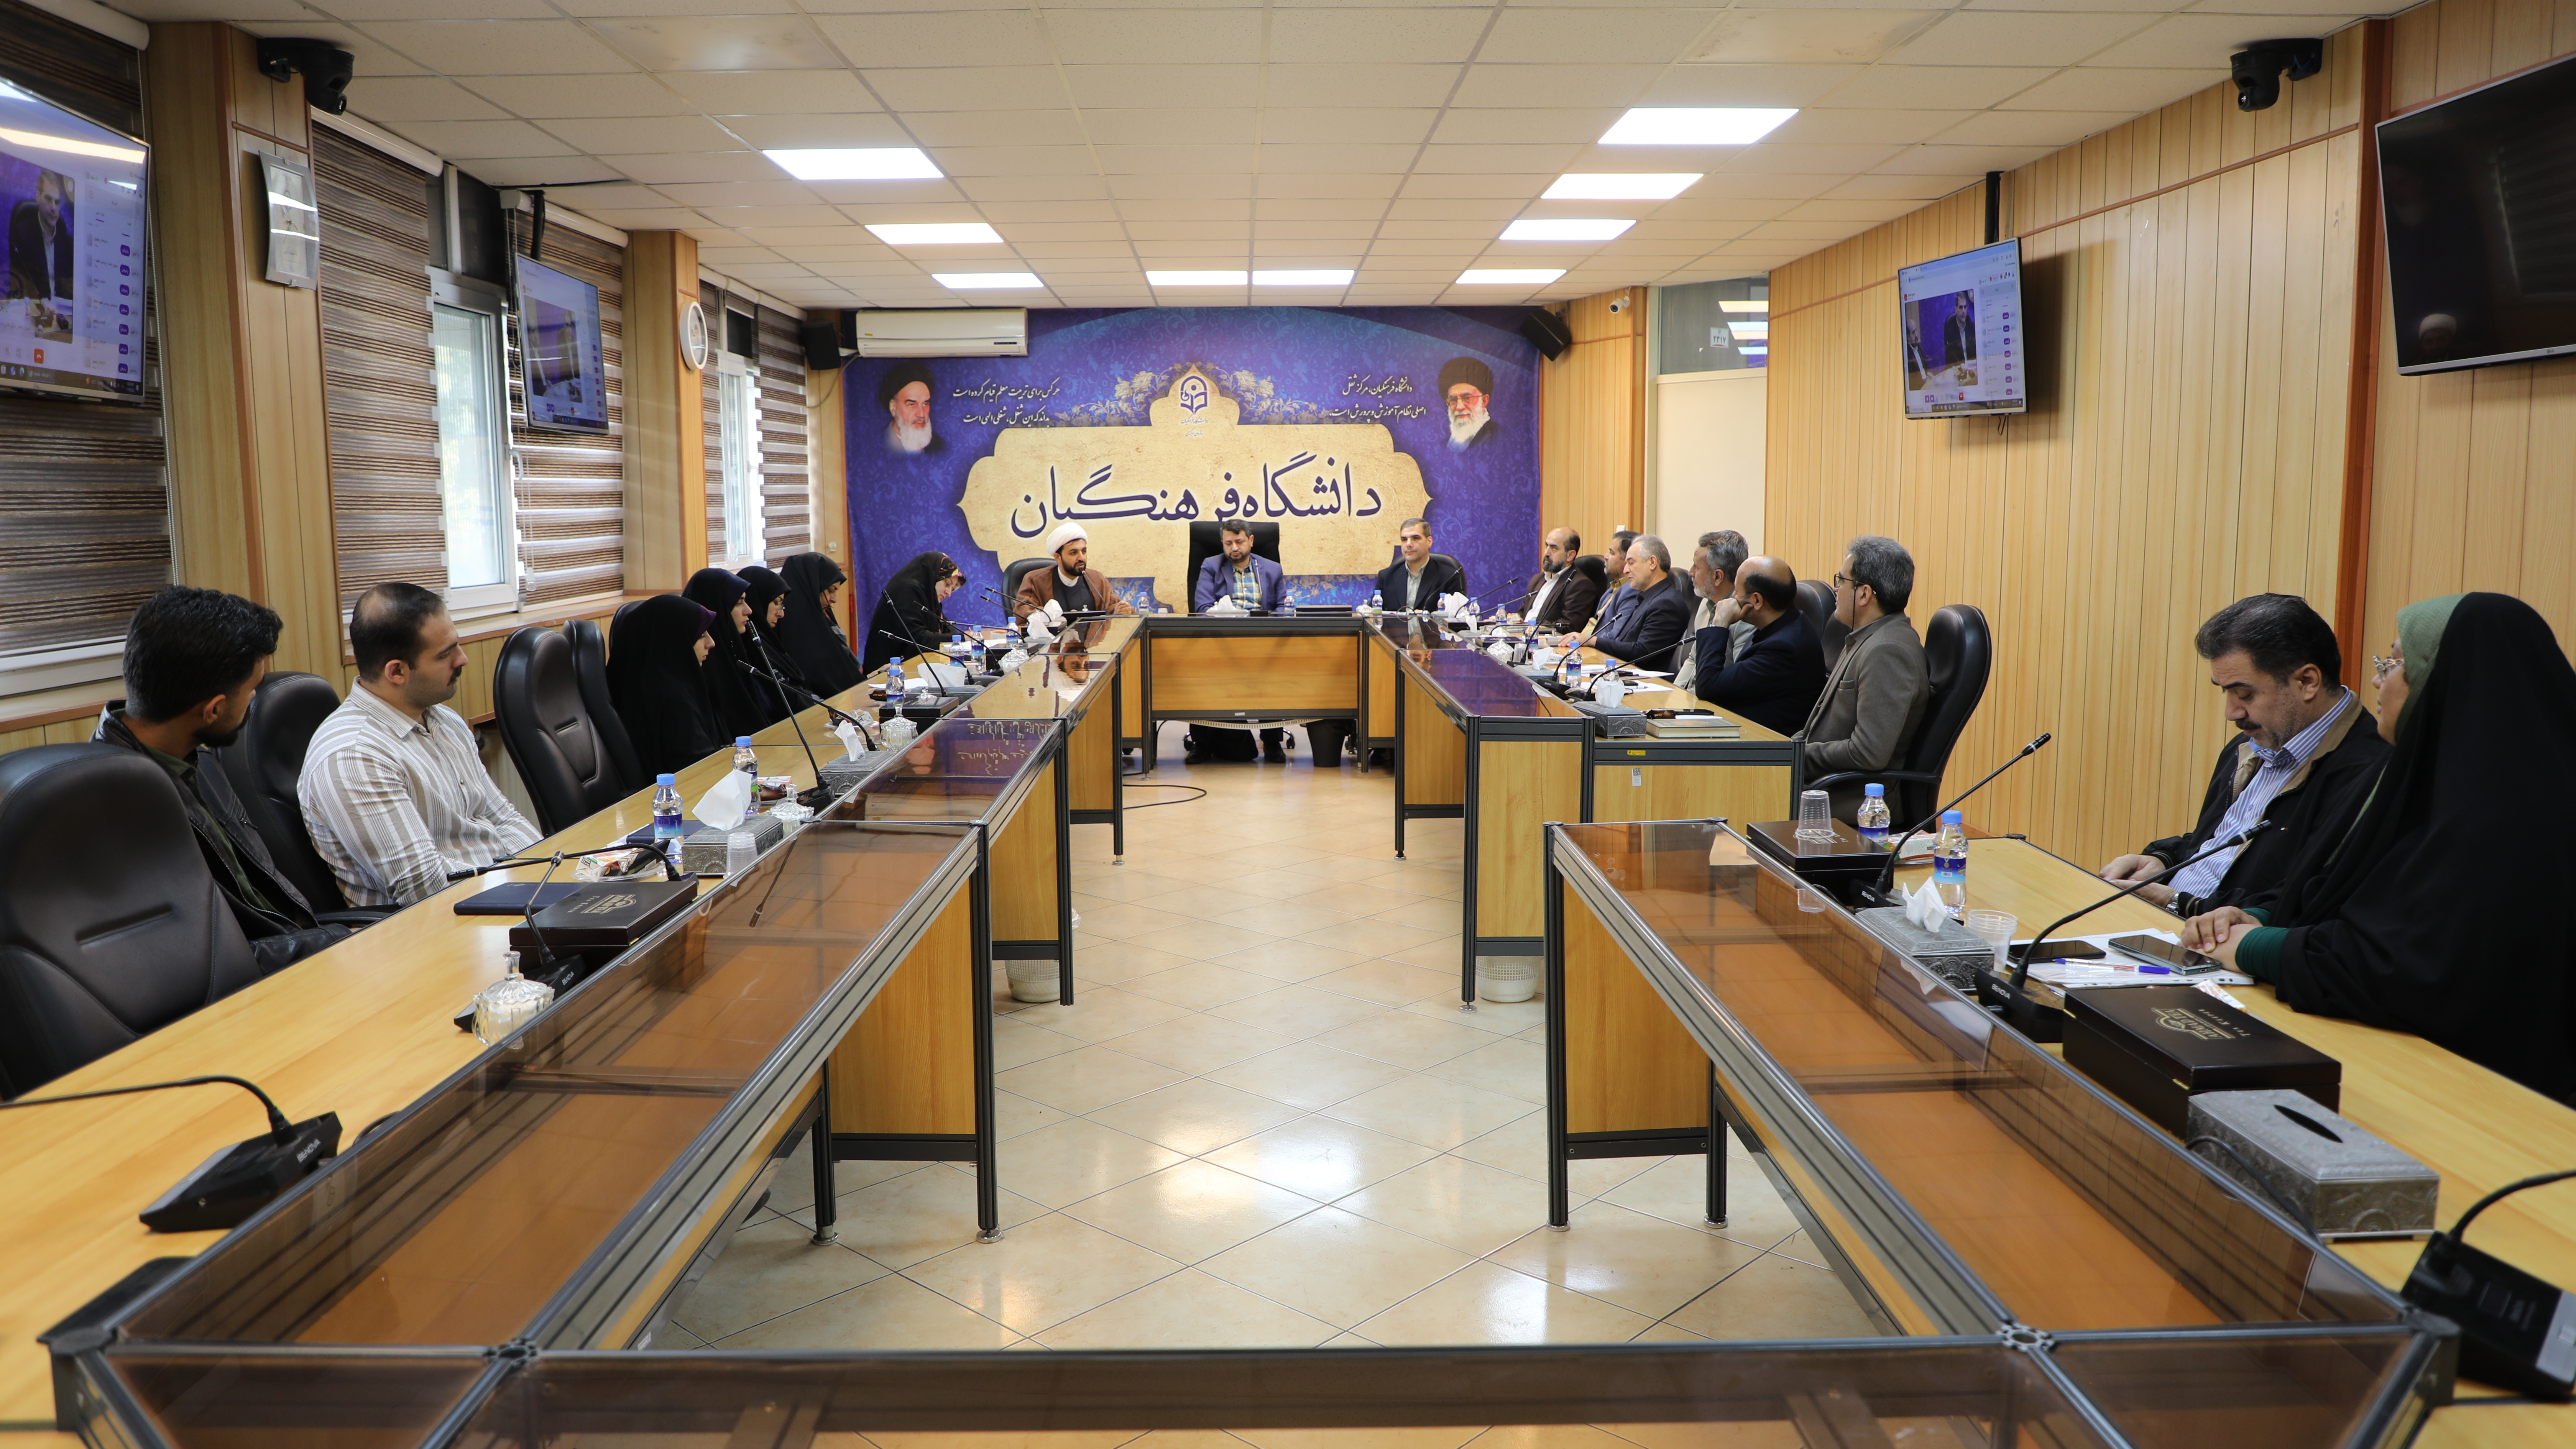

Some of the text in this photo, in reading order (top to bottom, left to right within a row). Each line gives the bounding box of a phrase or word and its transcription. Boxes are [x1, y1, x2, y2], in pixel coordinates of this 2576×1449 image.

[1008, 384, 1028, 400] تربیت
[1042, 377, 1060, 398] کس
[1342, 374, 1357, 395] ثقل
[1356, 374, 1371, 395] مرکز
[1395, 376, 1413, 392] دانشگاه
[953, 389, 971, 397] است
[983, 384, 996, 404] قیام
[995, 386, 1008, 404] معلم
[1027, 387, 1042, 401] برای
[981, 411, 993, 424] الهی
[992, 405, 1007, 424] شغلی
[1033, 405, 1046, 422] که
[1038, 411, 1050, 427] بداند
[1350, 403, 1371, 423] پرورش
[1374, 403, 1400, 418] آموزش
[1396, 405, 1412, 423] نظام
[1411, 406, 1426, 418] اصلی
[1022, 414, 1033, 427] این
[1244, 451, 1382, 517] دانشگاه
[1991, 983, 2010, 999] BENOVA
[2180, 1019, 2222, 1037] AHMAD
